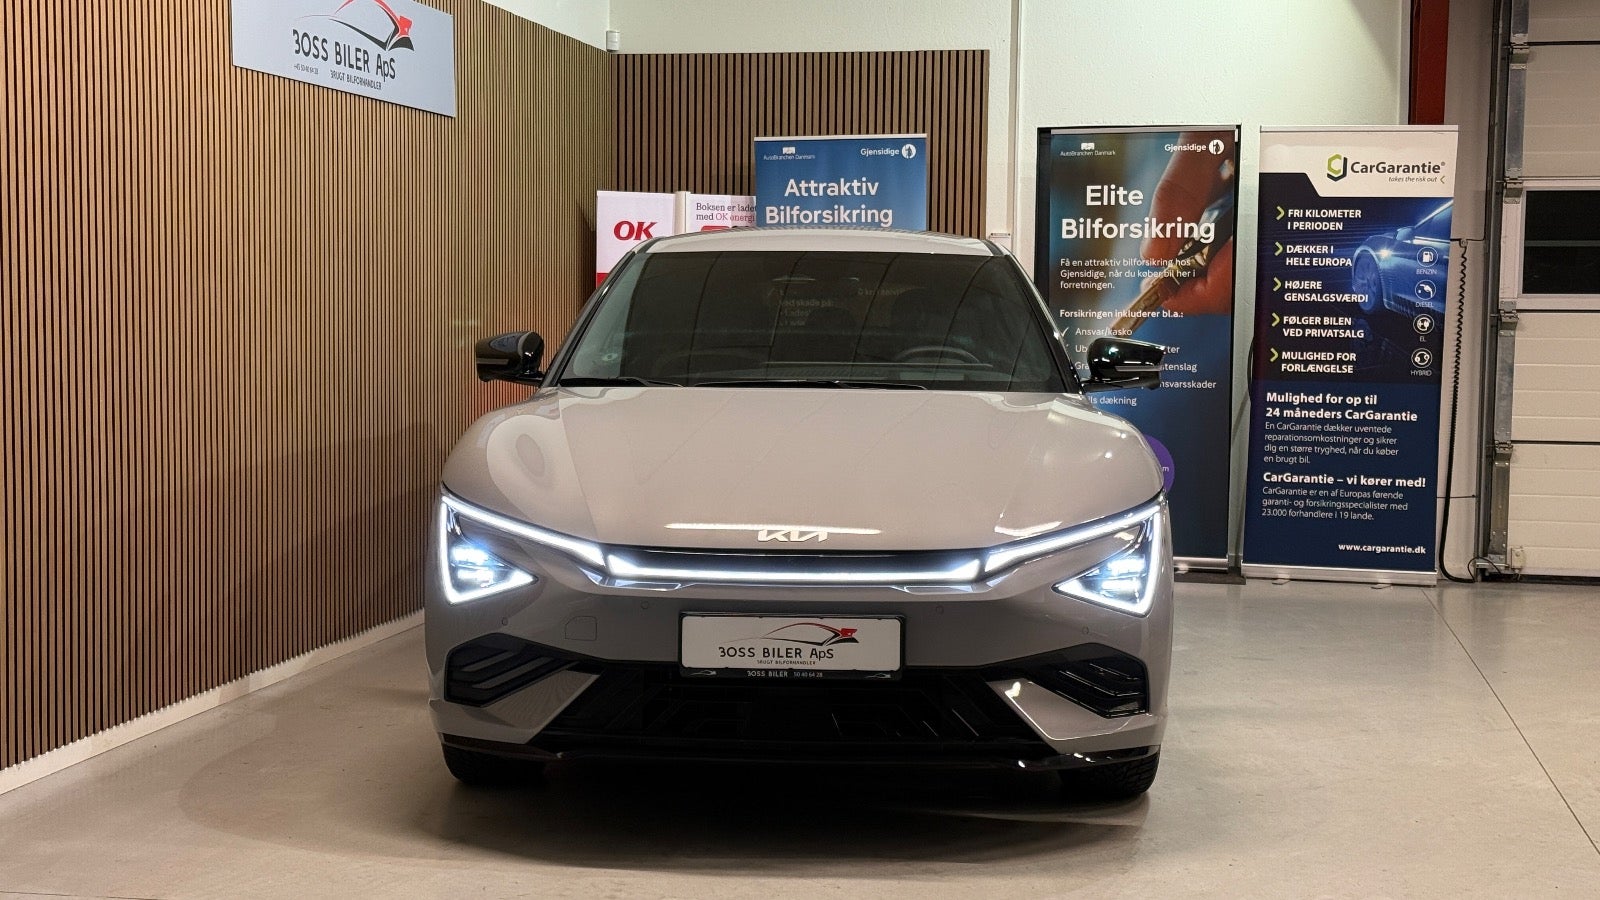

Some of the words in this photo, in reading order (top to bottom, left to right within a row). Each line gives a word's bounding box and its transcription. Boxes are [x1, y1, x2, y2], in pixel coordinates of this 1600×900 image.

[334, 42, 370, 72] BILER
[376, 54, 396, 82] ApS
[860, 148, 899, 157] Gjensidige
[1164, 144, 1207, 153] Gjensidige
[784, 177, 879, 197] Attraktiv
[1086, 184, 1144, 206] Elite
[696, 202, 725, 211] Boksen
[730, 214, 755, 223] energi
[766, 205, 893, 227] Bilforsikring
[1288, 209, 1303, 218] FRI
[1305, 209, 1362, 218] KILOMETER
[614, 220, 658, 240] OK
[1061, 217, 1216, 244] Bilforsikring
[1287, 222, 1290, 230] I
[1292, 222, 1343, 230] PERIODEN
[1286, 245, 1328, 254] DÆKKER
[1331, 246, 1334, 254] I
[1060, 258, 1070, 266] Få
[1084, 258, 1120, 266] attraktiv
[1122, 258, 1173, 268] bilforsikring
[1175, 258, 1191, 266] hos
[1286, 257, 1311, 266] HELE
[1313, 258, 1352, 267] EUROPA
[1060, 270, 1106, 279] Gjensidige,
[1109, 269, 1122, 278] når
[1124, 270, 1135, 278] du
[1138, 269, 1161, 278] køber
[1164, 269, 1174, 278] bil
[1176, 269, 1191, 278] her
[1192, 269, 1195, 277] i
[1060, 281, 1115, 290] forretningen.
[1284, 280, 1322, 290] HØJERE
[1284, 293, 1368, 303] GENSALGSVÆRDI
[1059, 310, 1113, 320] Forsikringen
[1115, 310, 1160, 318] inkluderer
[1162, 310, 1184, 318] bl.a.:
[1283, 316, 1321, 325] FØLGER
[1323, 316, 1352, 326] BILEN
[1075, 328, 1133, 337] Ansvar/kasko
[1283, 328, 1302, 337] VED
[1305, 328, 1364, 339] PRIVATSALG
[1281, 351, 1334, 361] MULIGHED
[1336, 352, 1356, 361] FOR
[1074, 362, 1089, 370] Gra
[1281, 364, 1353, 373] FORLÆNGELSE
[1160, 380, 1216, 388] nsvarsskader
[1100, 396, 1137, 407] dækning
[1266, 392, 1323, 406] Mulighed
[1326, 394, 1343, 404] for
[1346, 396, 1362, 406] op
[1364, 394, 1377, 405] til
[1266, 408, 1280, 417] 24
[1283, 408, 1342, 419] måneders
[1345, 410, 1418, 421] CarGarantie
[1265, 422, 1275, 430] En
[1276, 422, 1322, 431] CarGarantie
[1324, 424, 1352, 432] dækker
[1354, 425, 1392, 433] uventede
[1265, 434, 1362, 445] reparationsomkostninger
[1364, 437, 1374, 445] og
[1376, 436, 1397, 444] sikrer
[1264, 444, 1277, 453] dig
[1290, 445, 1312, 453] større
[1315, 446, 1347, 455] tryghed,
[1349, 446, 1361, 454] når
[1375, 447, 1399, 455] køber
[1275, 455, 1297, 464] brugt
[1263, 472, 1334, 484] CarGarantie
[1346, 475, 1358, 485] vi
[1360, 476, 1393, 486] kører
[1395, 478, 1426, 487] med!
[1262, 487, 1308, 496] CarGarantie
[1340, 490, 1371, 499] Europas
[1372, 490, 1404, 499] førende
[1262, 499, 1292, 507] garanti-
[1294, 500, 1304, 508] og
[1306, 499, 1388, 510] forsikringsspecialister
[1262, 509, 1287, 517] 23.000
[1289, 509, 1333, 518] forhandlere
[1350, 512, 1374, 520] lande.
[758, 530, 829, 542] KIA
[1338, 543, 1426, 554] www.cargarantie.dk
[762, 647, 802, 658] BILER
[809, 648, 834, 661] ApS
